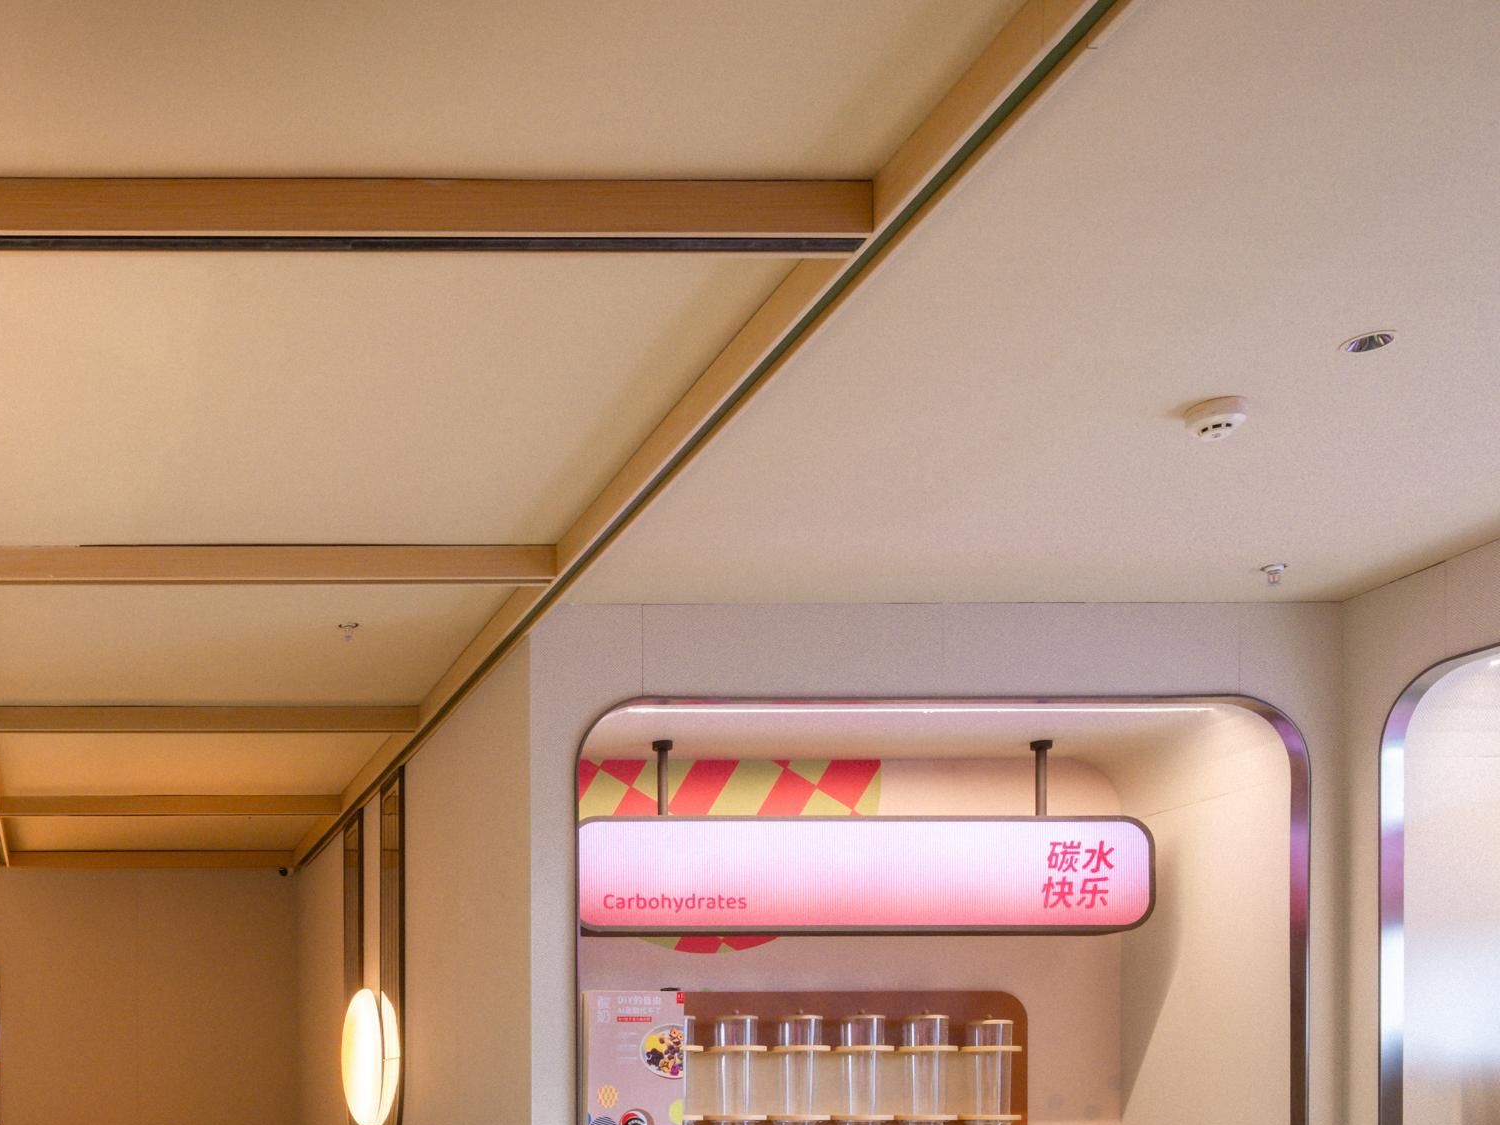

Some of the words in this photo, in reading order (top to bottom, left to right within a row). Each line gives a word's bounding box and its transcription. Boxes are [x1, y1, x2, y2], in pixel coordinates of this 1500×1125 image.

[1047, 840, 1115, 873] 碳水
[603, 893, 748, 913] Carbohydrates
[1041, 876, 1109, 909] 快乐
